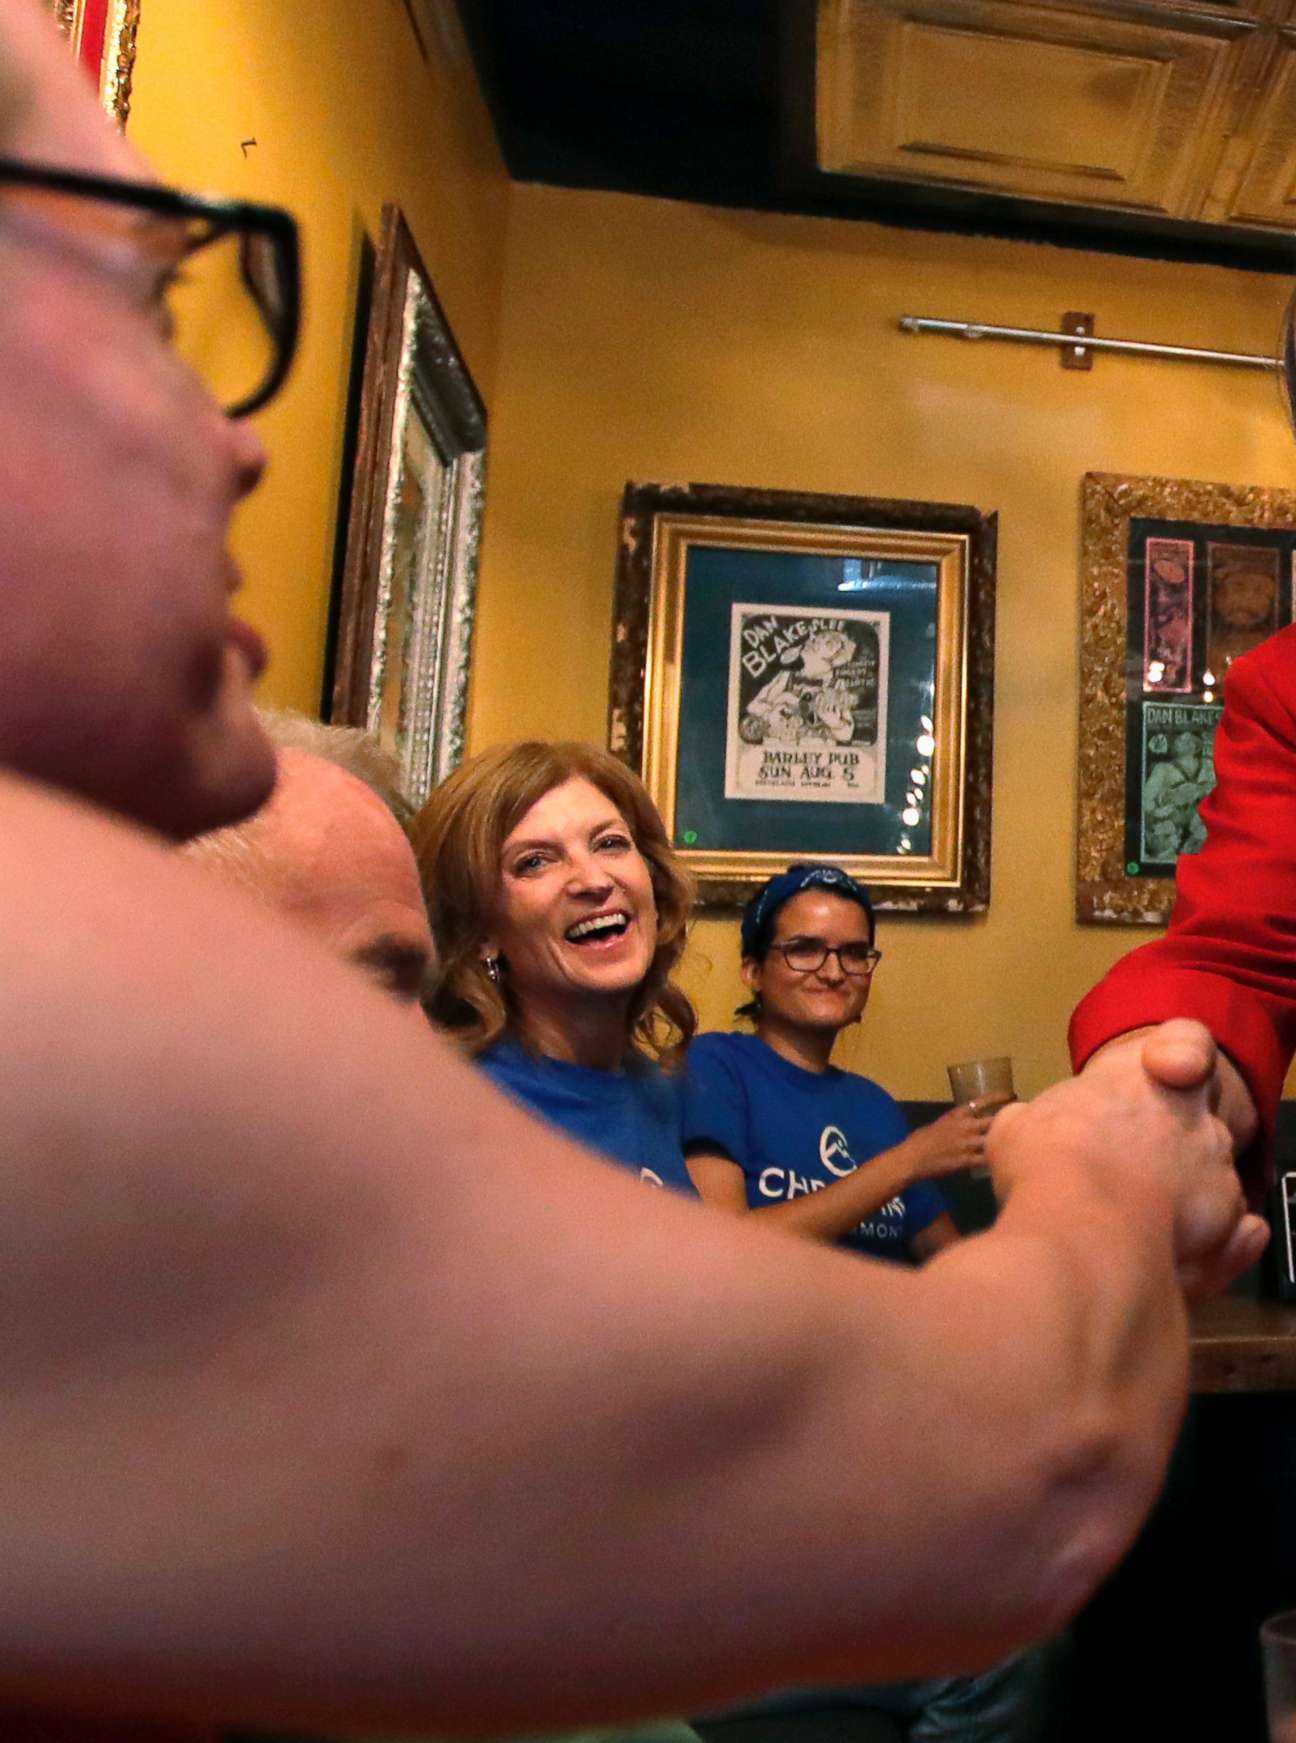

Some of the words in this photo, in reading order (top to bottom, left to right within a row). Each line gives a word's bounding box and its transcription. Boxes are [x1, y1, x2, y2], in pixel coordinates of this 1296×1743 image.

[744, 616, 778, 648] DAN
[1147, 707, 1173, 724] DAN
[763, 751, 822, 764] BARLEY
[829, 751, 859, 765] PUB
[759, 766, 791, 778] SUN
[800, 765, 832, 779] AUG
